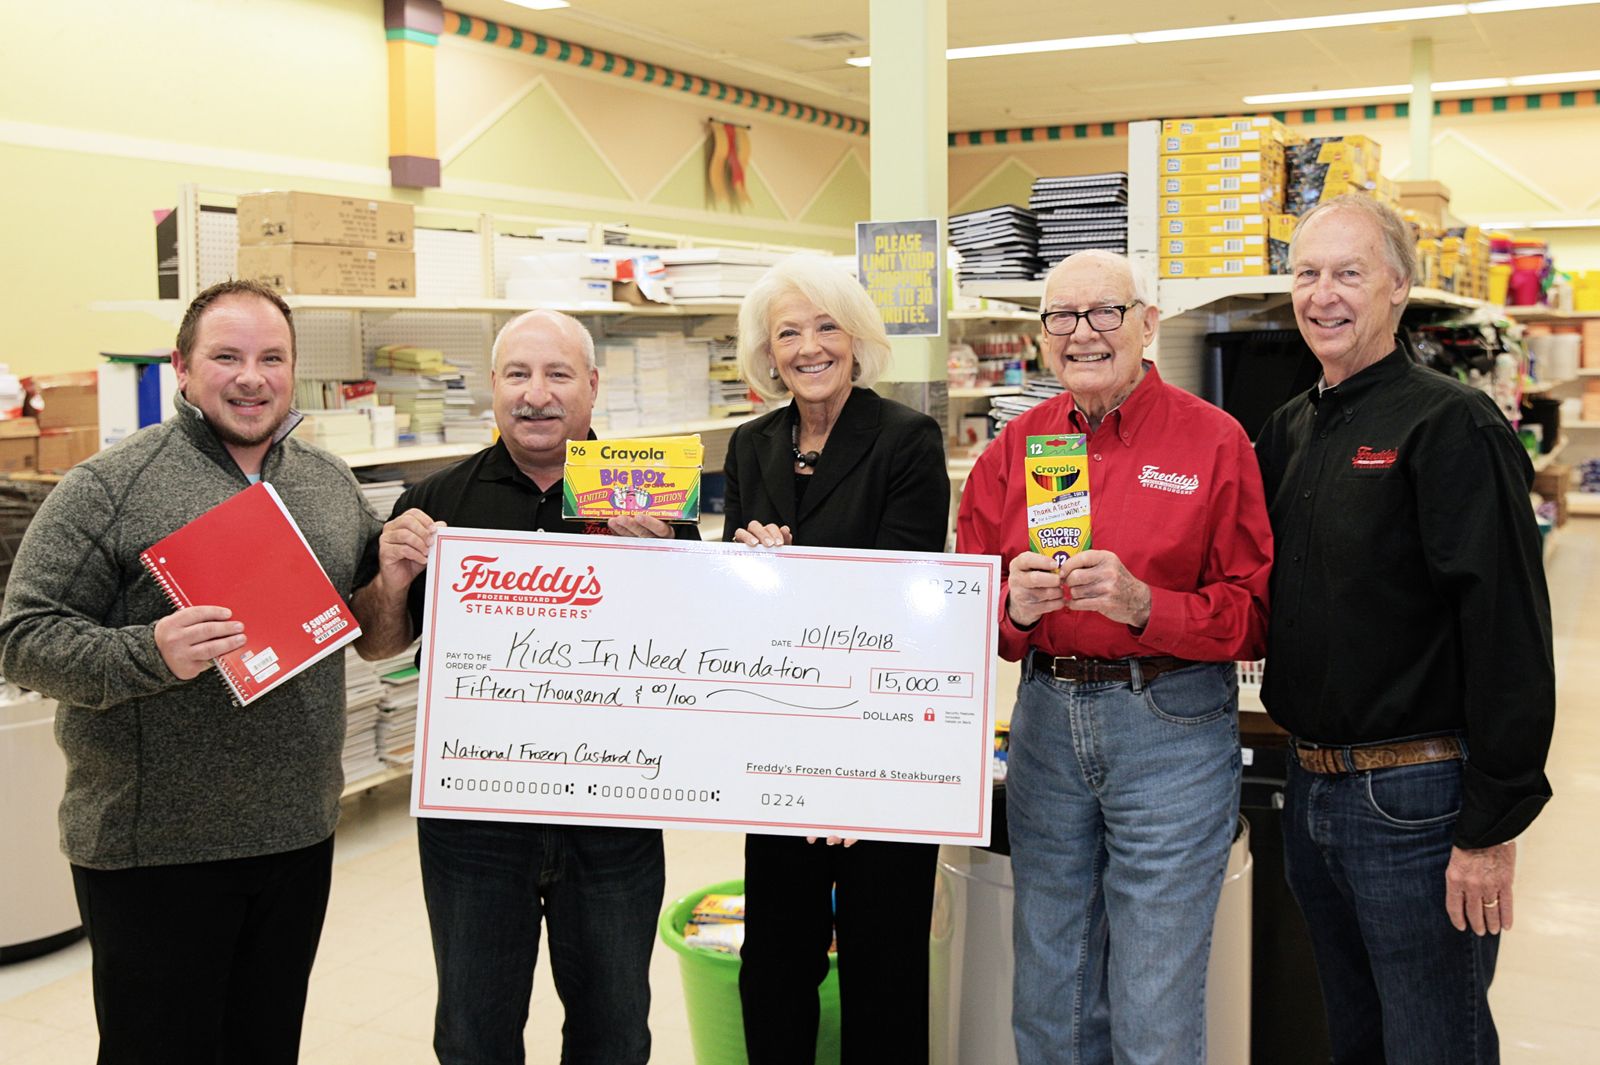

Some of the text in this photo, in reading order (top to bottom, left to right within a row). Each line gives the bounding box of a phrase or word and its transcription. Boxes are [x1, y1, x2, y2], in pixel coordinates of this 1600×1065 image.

[875, 234, 922, 253] PLEASE
[863, 251, 935, 271] LIMIT YOUR
[571, 446, 665, 462] 96 Crayola
[1030, 443, 1043, 455] 12
[1035, 464, 1076, 474] Crayola
[1138, 465, 1199, 489] Freddy's
[631, 469, 665, 489] BOX
[580, 490, 682, 503] LIMITED EDITION
[1038, 527, 1080, 539] COLORED
[1040, 537, 1080, 549] PENCILS
[452, 555, 602, 602] Freddy's
[477, 593, 509, 601] FROZEN
[513, 595, 549, 603] CUSTARD
[302, 604, 341, 634] 5 SUBJECT
[771, 640, 792, 648] DATE
[801, 625, 894, 654] 10/15/2018
[506, 628, 820, 683] Kids In Need Foundation
[445, 662, 474, 670] ORDER
[455, 675, 526, 702] Fifteen
[529, 680, 623, 706] Thousand
[863, 711, 914, 722] DOLLARS
[441, 738, 663, 780] National Frozen Custard Day
[746, 762, 961, 783] Freddy's Frozen Custard & Steakburgers
[761, 793, 805, 807] 0224
